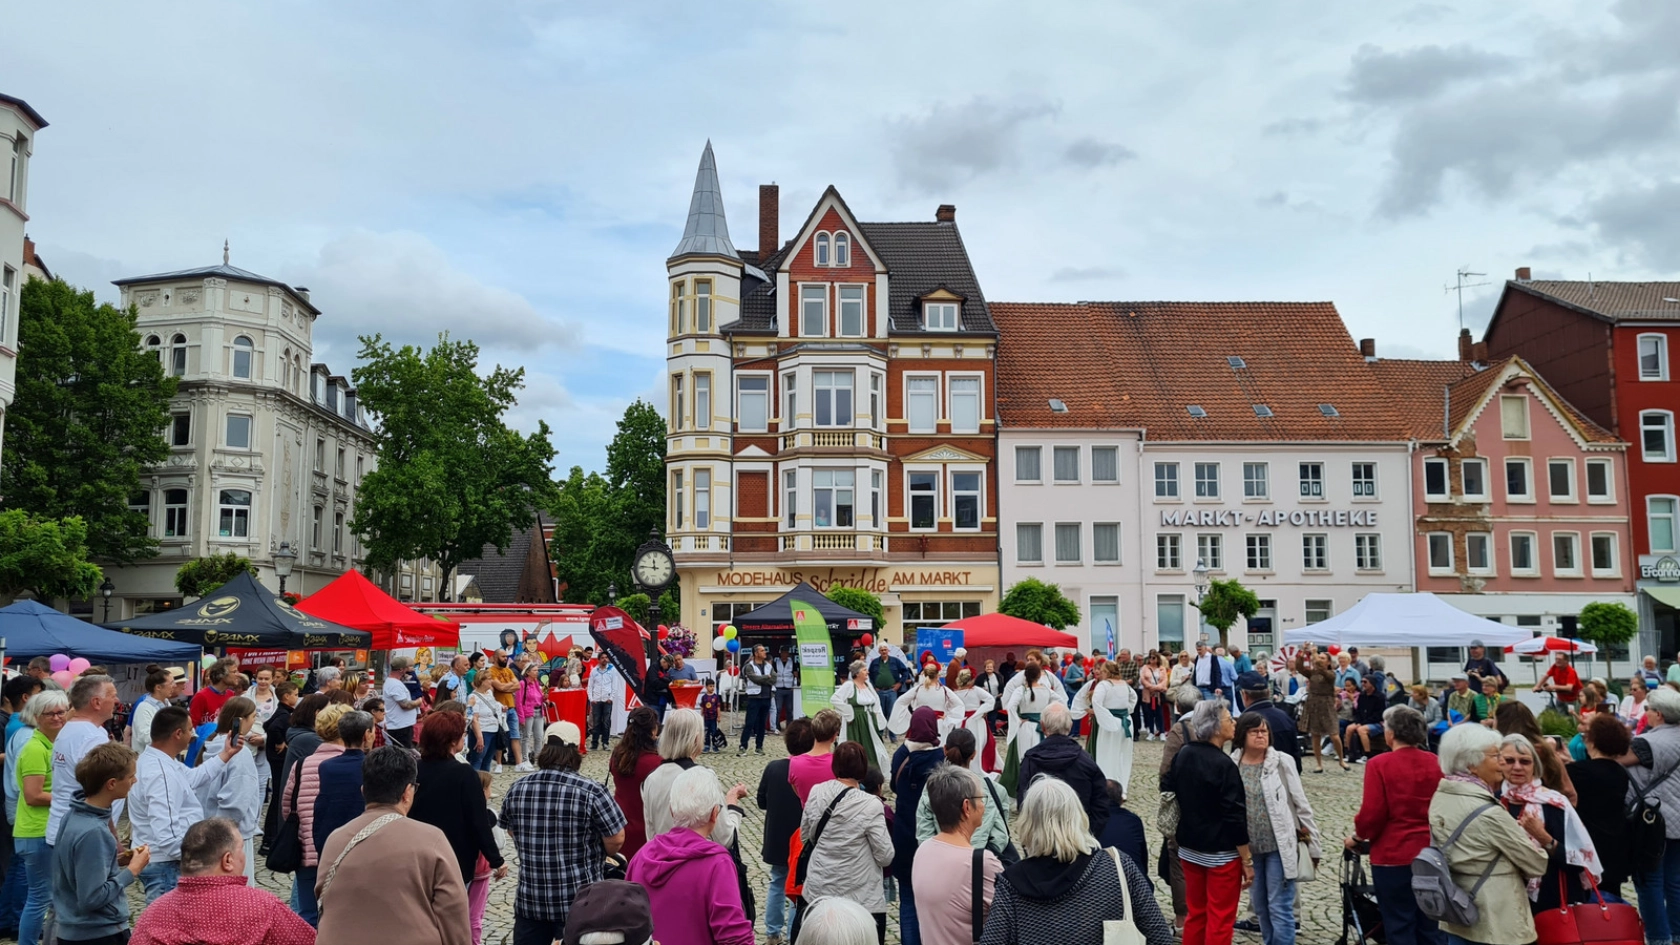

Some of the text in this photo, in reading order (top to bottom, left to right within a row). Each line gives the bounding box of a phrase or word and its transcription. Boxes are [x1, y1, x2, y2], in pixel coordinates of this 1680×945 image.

[1160, 510, 1378, 527] MARKT-APOTHEKE
[717, 568, 971, 593] MODEHAUS Schridde AM MARKT
[219, 633, 261, 643] 24MX
